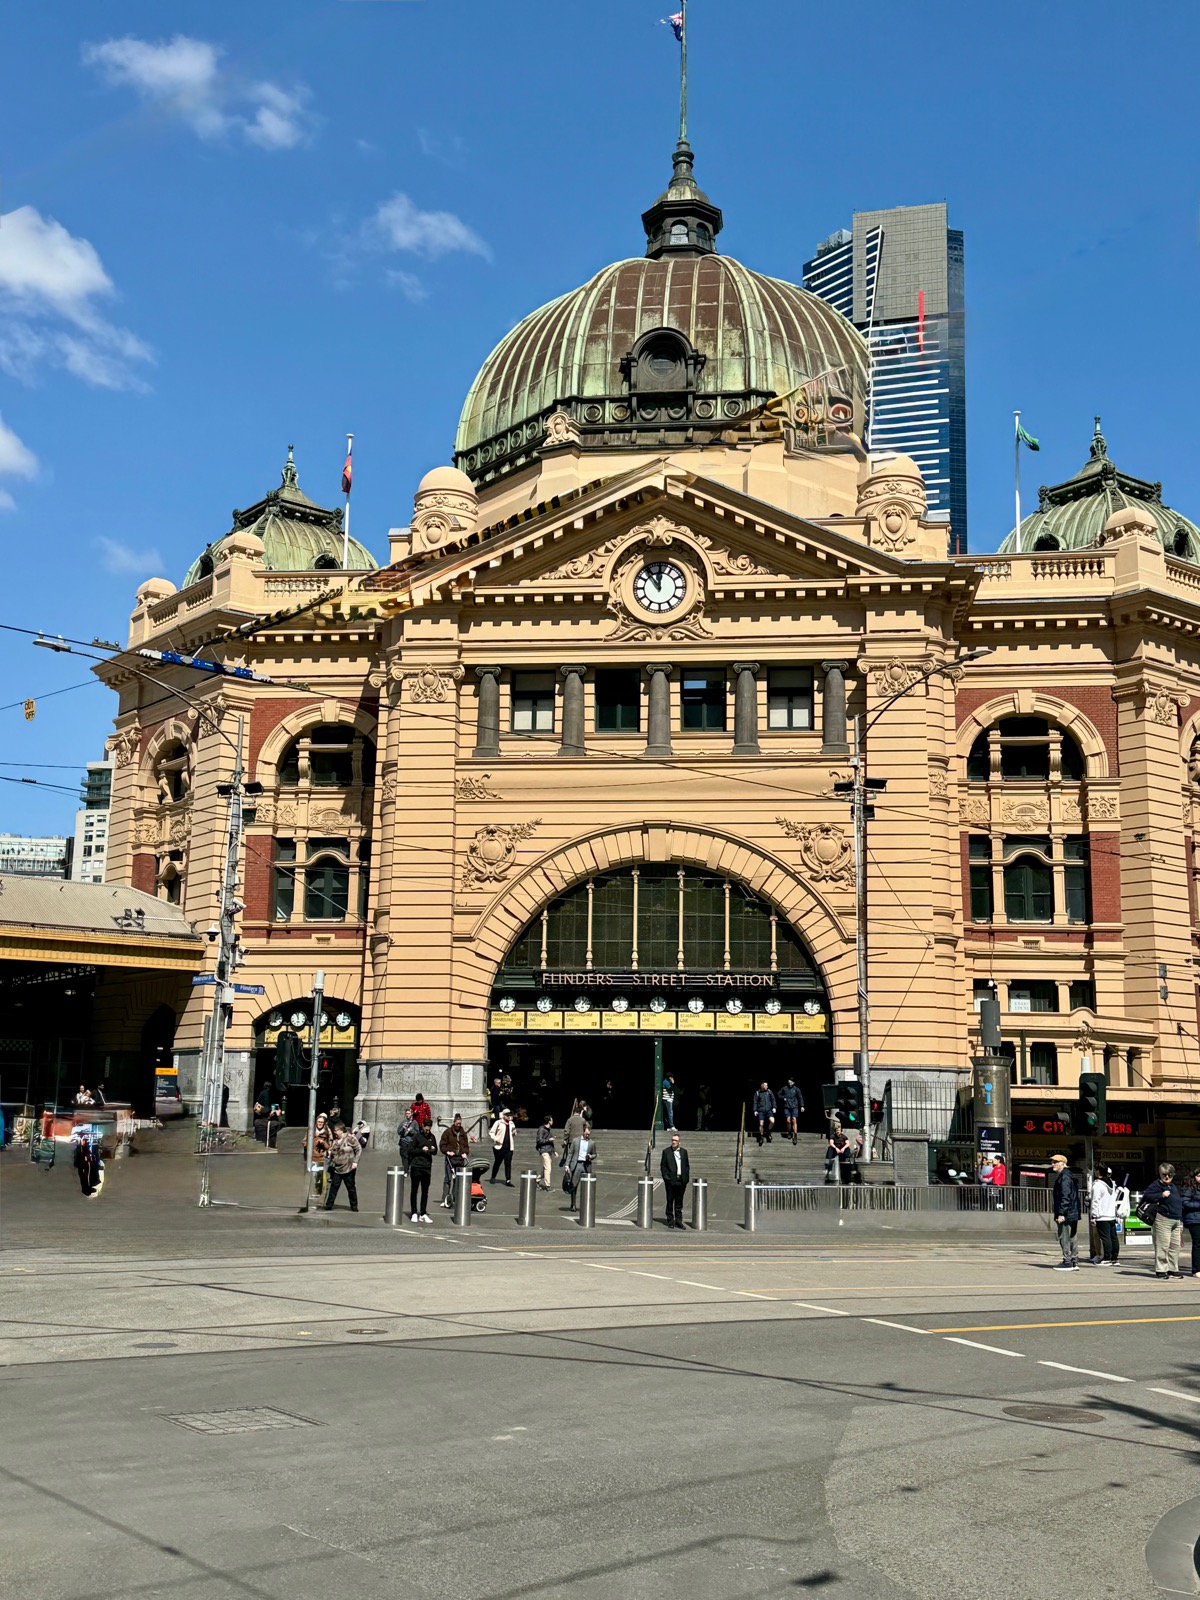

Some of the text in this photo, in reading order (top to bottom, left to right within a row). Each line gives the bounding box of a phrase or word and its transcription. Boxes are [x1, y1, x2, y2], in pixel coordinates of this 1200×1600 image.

[542, 973, 773, 986] FLINDERS STREET STATION
[1042, 1121, 1132, 1134] CIT TTERS
